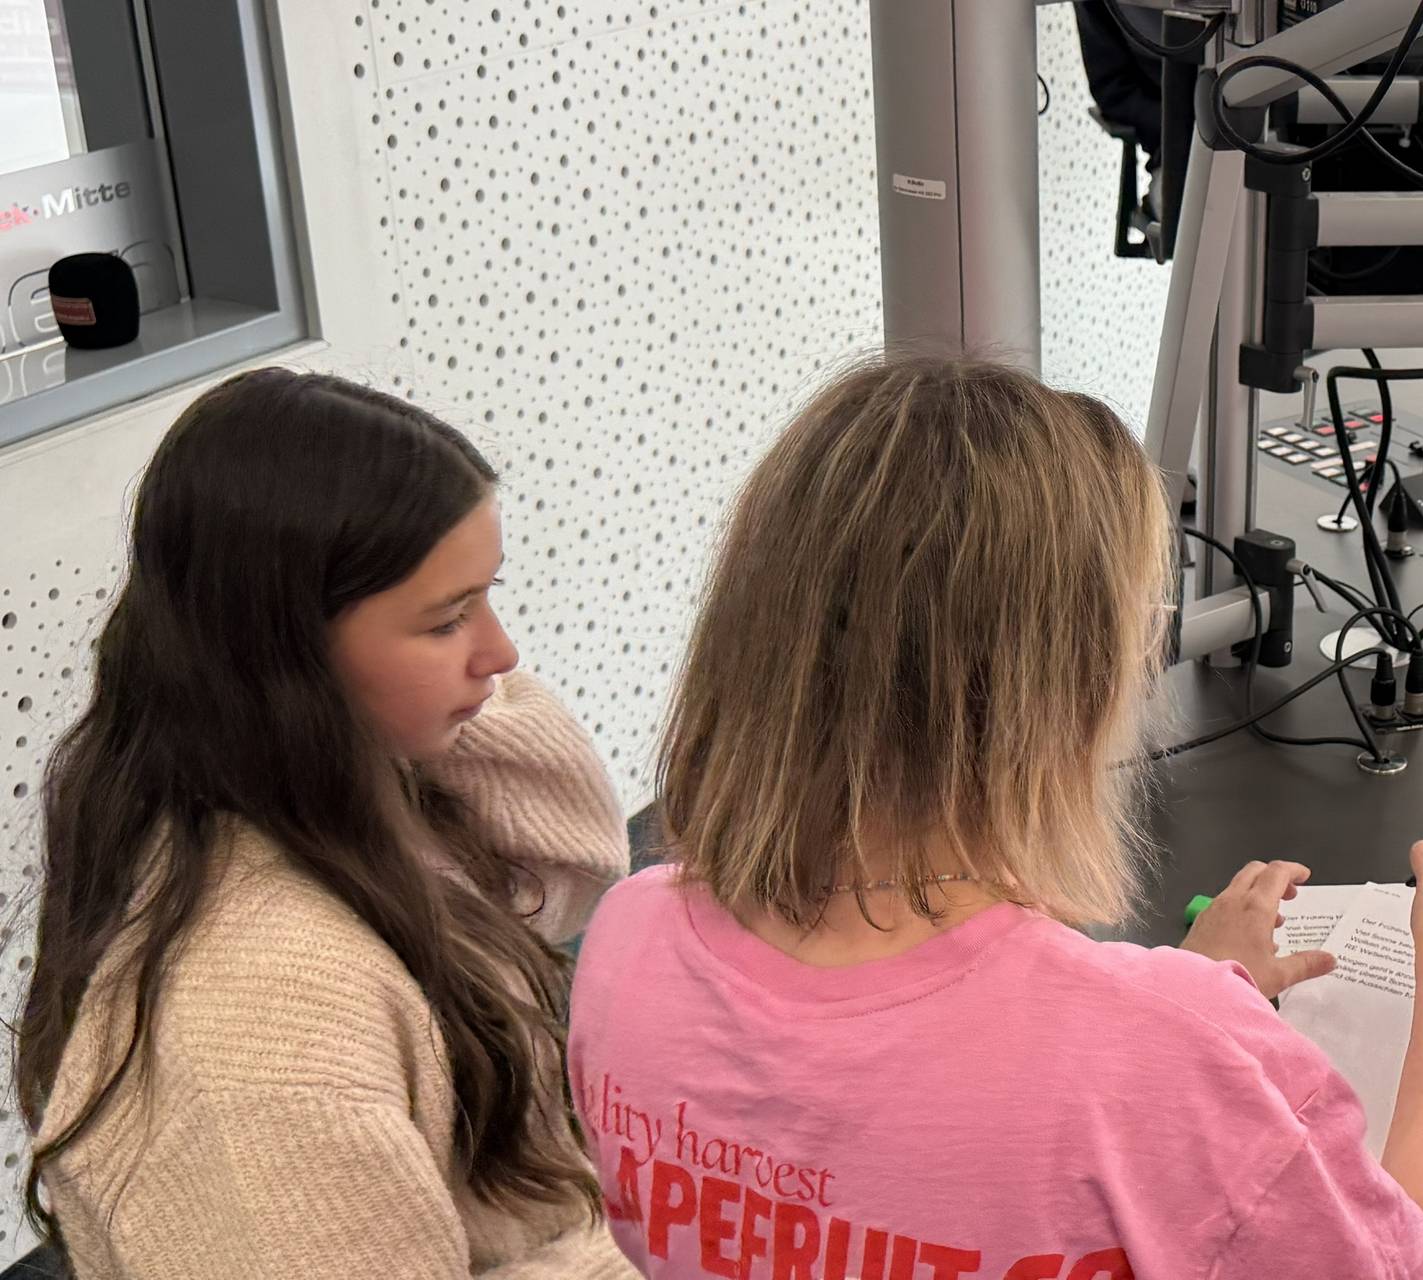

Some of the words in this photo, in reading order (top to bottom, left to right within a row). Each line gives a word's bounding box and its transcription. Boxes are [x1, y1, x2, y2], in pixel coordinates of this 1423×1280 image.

[41, 181, 132, 219] Mitte
[592, 1072, 662, 1168] lity
[675, 1101, 836, 1208] harvest
